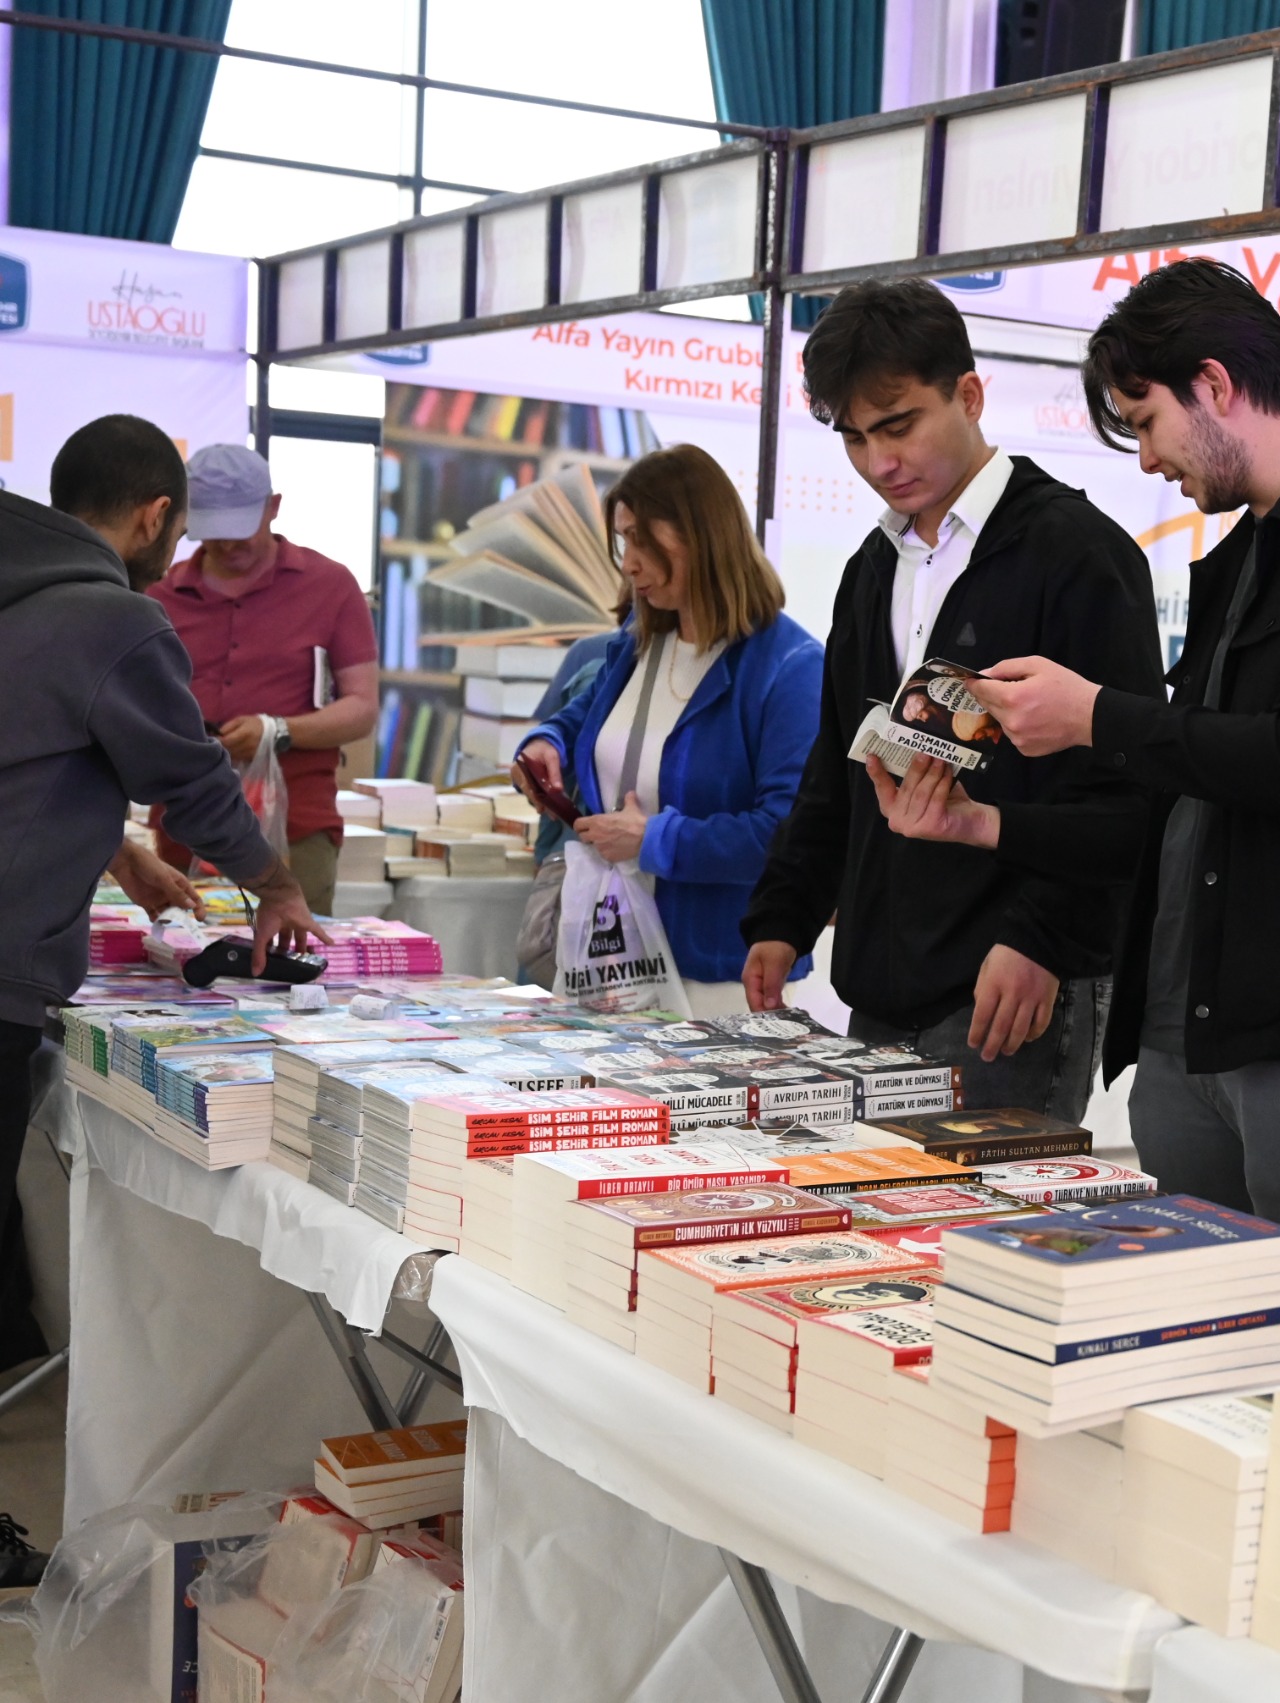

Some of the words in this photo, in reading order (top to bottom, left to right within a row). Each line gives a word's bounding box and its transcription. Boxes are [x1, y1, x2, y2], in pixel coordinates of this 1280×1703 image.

[532, 322, 592, 349] Alfa
[601, 328, 676, 362] Yayın
[623, 367, 722, 401] Kırmızı
[897, 735, 962, 765] PADİŞAHLARI
[912, 731, 957, 753] OSMANLI
[589, 935, 622, 953] Bilgi
[875, 1077, 904, 1089] ATATÜRK
[905, 1076, 913, 1086] VE
[914, 1074, 942, 1085] DÜNYASI
[688, 1094, 733, 1109] MÜCADELE
[773, 1088, 810, 1104] AVRUPA
[812, 1086, 842, 1101] TARİHİ
[877, 1098, 906, 1112] ATATÜRK
[907, 1098, 915, 1108] VE
[917, 1096, 944, 1107] DÜNYASI
[528, 1112, 552, 1125] İSİM
[555, 1111, 588, 1125] ŞEHİR
[592, 1109, 618, 1121] FİLM
[621, 1107, 658, 1120] ROMAN
[812, 1109, 842, 1123] TARİHİ
[530, 1126, 553, 1138] İSİM
[556, 1125, 590, 1138] ŞEHİR
[593, 1123, 619, 1135] FİLM
[621, 1121, 658, 1134] ROMAN
[529, 1140, 553, 1152] İSİM
[555, 1139, 589, 1152] ŞEHİR
[592, 1136, 618, 1149] FİLM
[621, 1134, 658, 1147] ROMAN
[981, 1148, 1007, 1159] FÂTİH
[1008, 1146, 1041, 1157] SULTAN
[1043, 1143, 1080, 1153] MEHMED
[599, 1180, 622, 1195] İLBER
[623, 1178, 654, 1194] ORTAYLI
[668, 1177, 681, 1192] BİR
[682, 1176, 704, 1190] ÖMÜR
[1055, 1186, 1099, 1201] TÜRKİYE'NİN
[1100, 1184, 1122, 1197] YAKIN
[1123, 1182, 1147, 1193] TARİHİ
[675, 1220, 740, 1242] CUMHURİYET'İN
[741, 1219, 755, 1236] İLK
[756, 1217, 788, 1235] YÜZYILI
